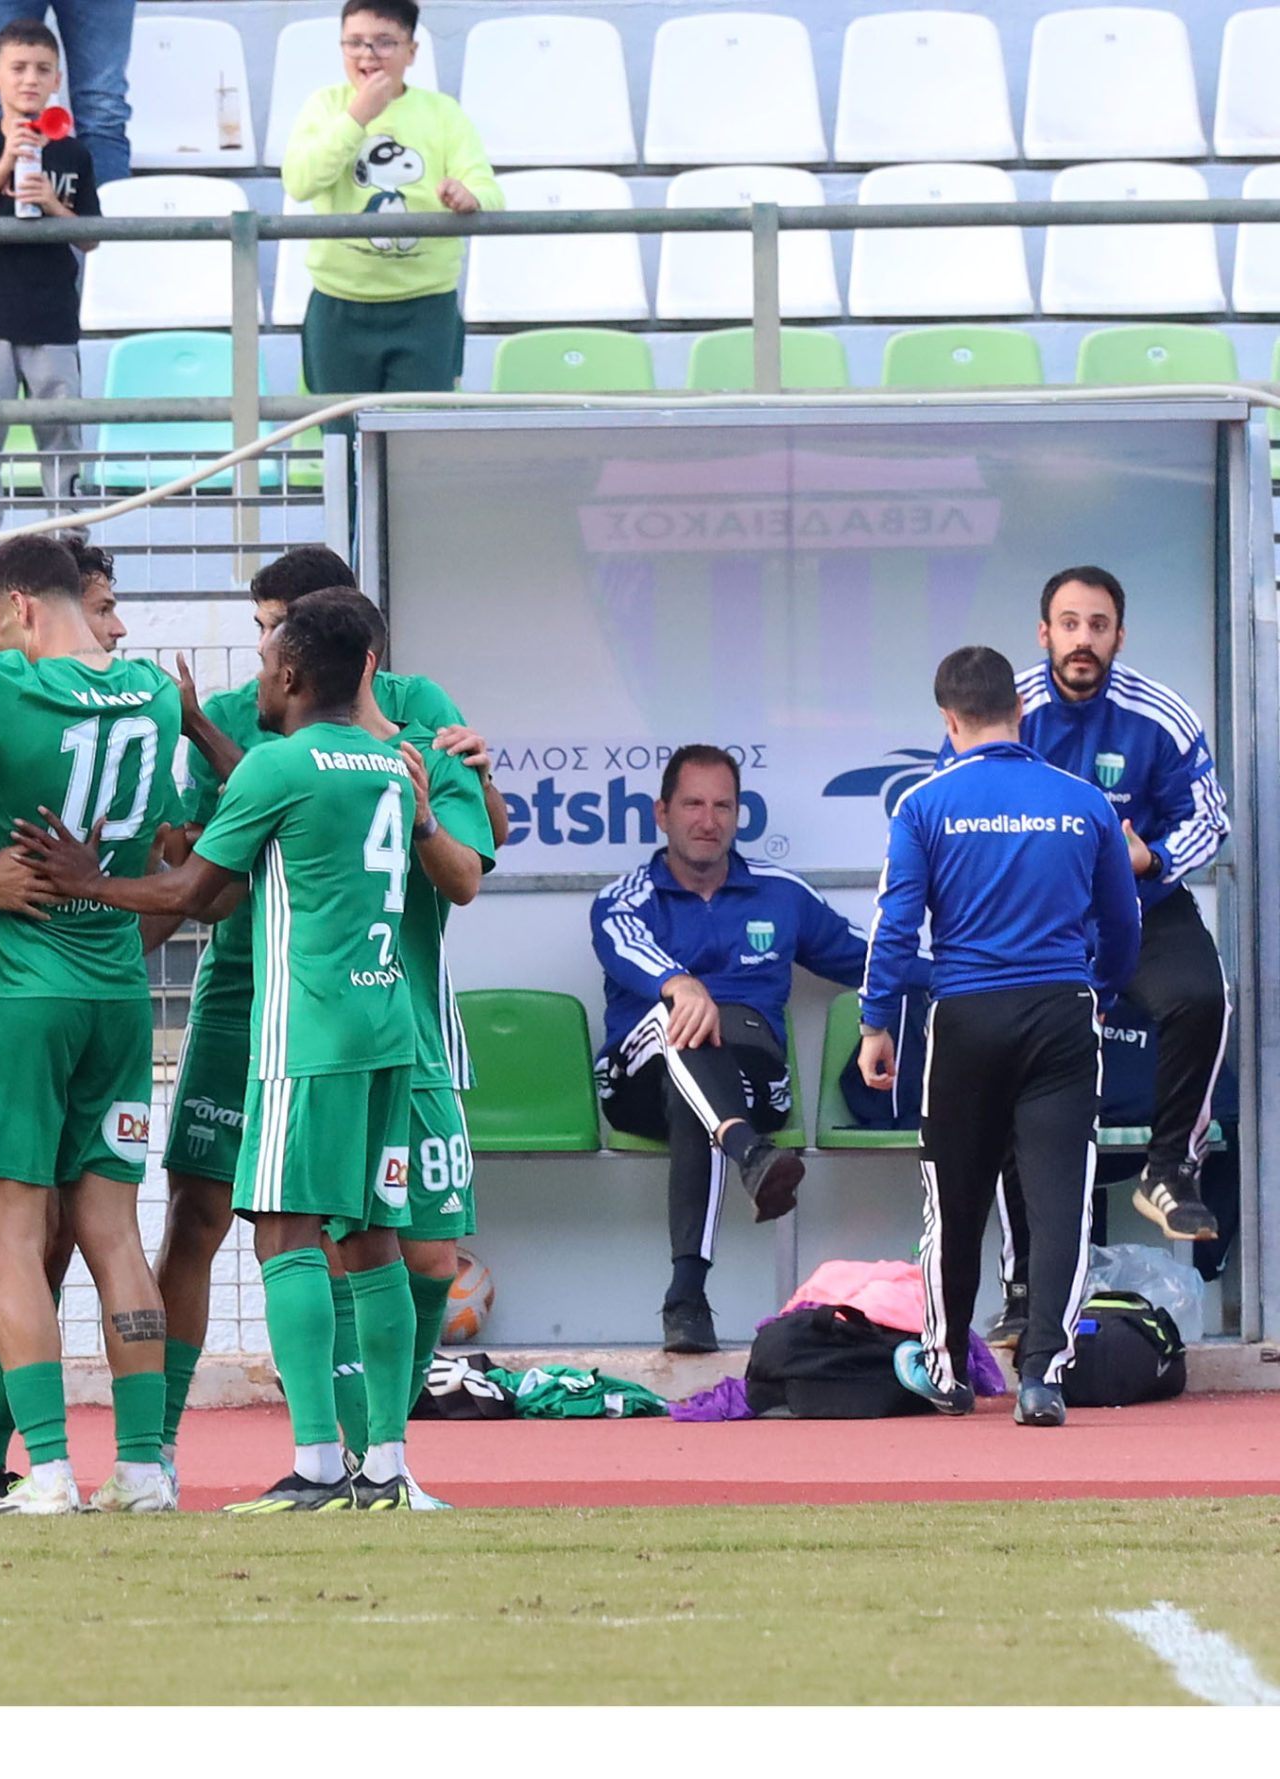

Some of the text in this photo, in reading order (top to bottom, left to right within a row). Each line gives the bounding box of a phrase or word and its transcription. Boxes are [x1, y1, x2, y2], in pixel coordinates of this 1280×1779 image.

[604, 744, 768, 770] ΧΟΡΟΣ
[48, 715, 159, 843] 10
[945, 814, 1086, 835] Levadiakos FC
[363, 780, 406, 913] 4
[1104, 1026, 1149, 1049] Leva
[420, 1133, 466, 1192] 88
